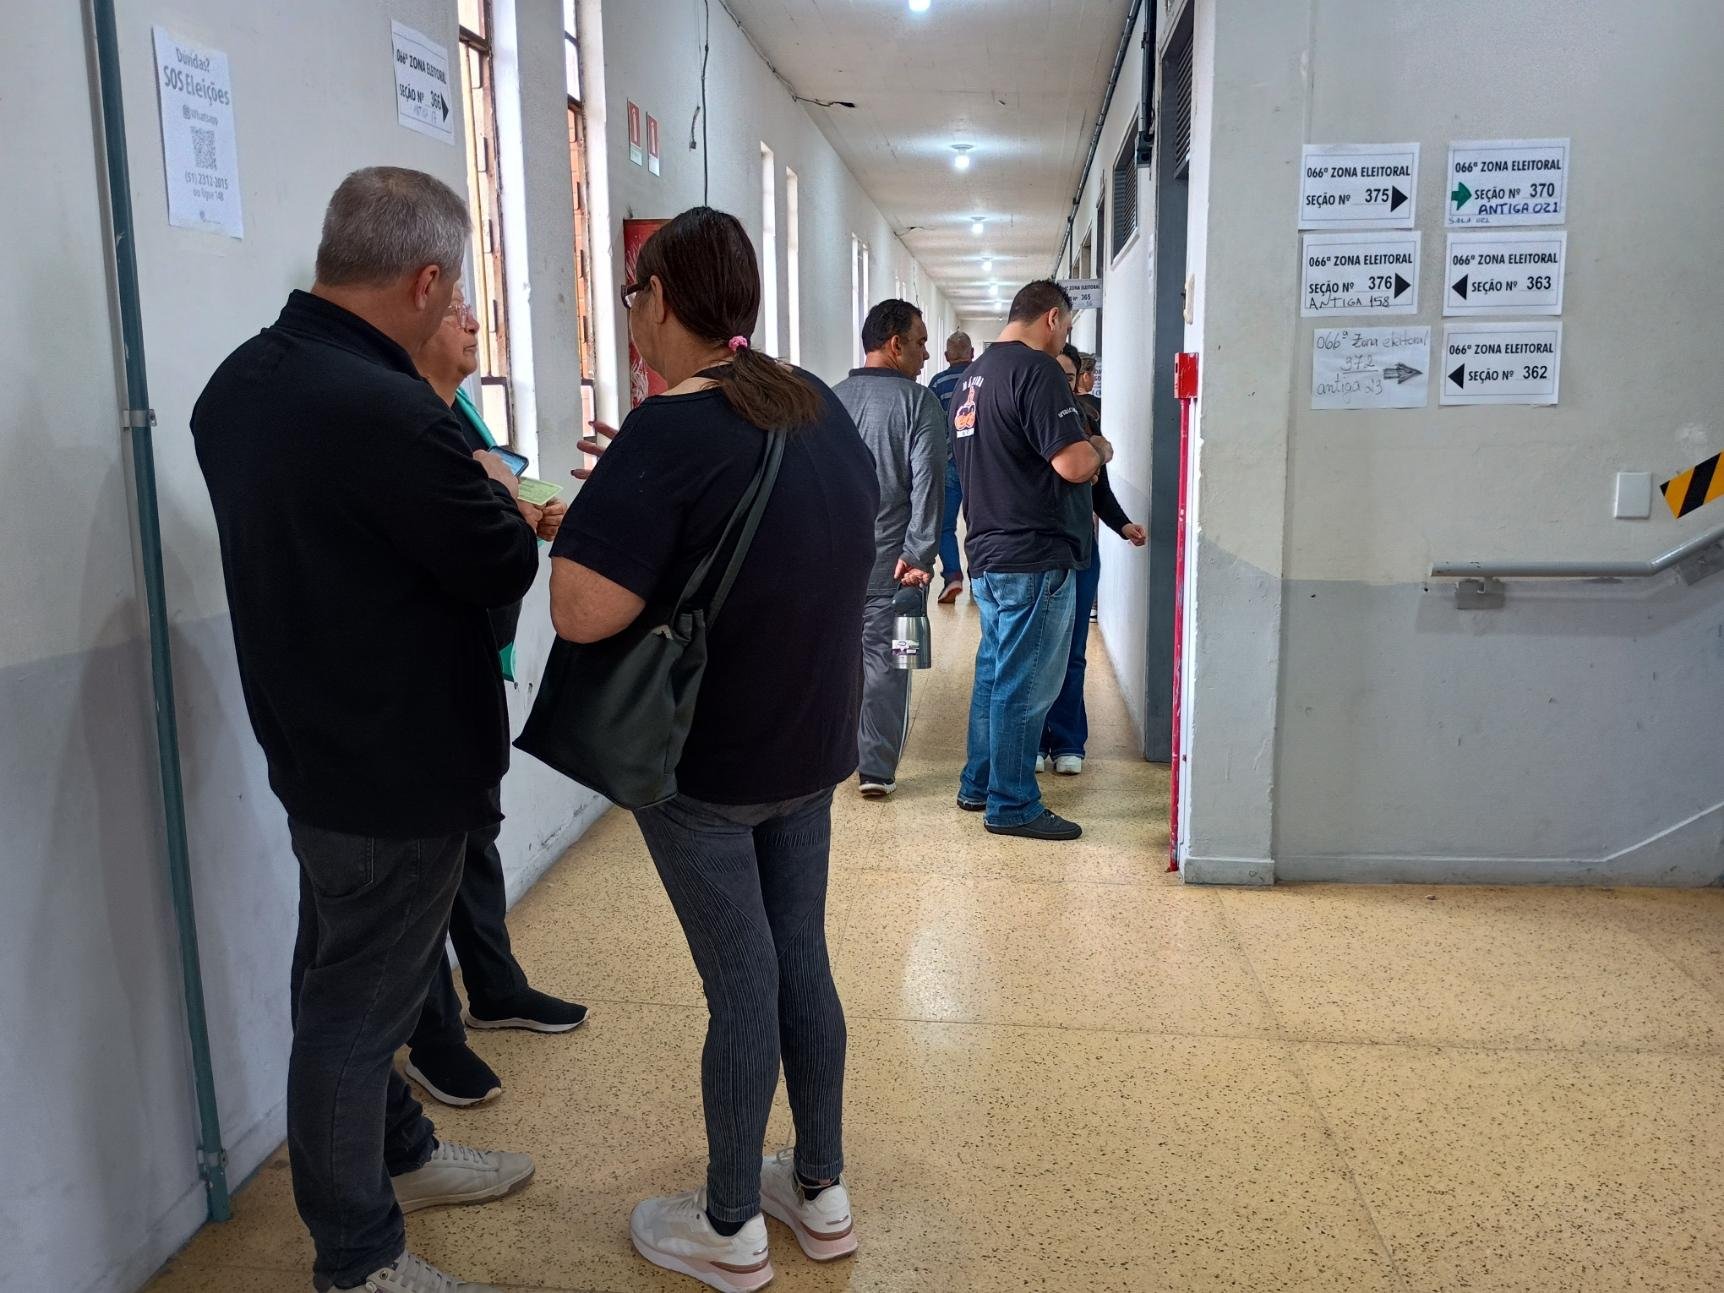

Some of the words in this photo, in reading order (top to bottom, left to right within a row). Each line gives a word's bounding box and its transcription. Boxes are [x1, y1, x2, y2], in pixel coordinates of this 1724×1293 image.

[409, 55, 426, 74] ZONA
[426, 62, 447, 85] ELEITORAL
[163, 65, 184, 92] SOS
[185, 73, 230, 106] Eleições
[399, 83, 416, 102] SEÇÃO
[1330, 167, 1358, 178] ZONA
[1360, 165, 1411, 177] ELEITORAL
[1480, 160, 1509, 172] ZONA
[1511, 159, 1562, 171] ELEITORAL
[1306, 192, 1336, 208] SEÇÃO
[1338, 194, 1351, 205] Nº
[1364, 188, 1390, 203] 375
[1474, 187, 1506, 202] SEÇÃO
[1508, 188, 1520, 199] Nº
[1529, 182, 1555, 198] 370
[1478, 202, 1529, 216] ANTIGA
[1333, 255, 1361, 266] ZONA
[1363, 253, 1413, 265] ELEITORAL
[1477, 254, 1506, 265] ZONA
[1508, 252, 1558, 264] ELEITORAL
[1308, 281, 1339, 296] SEÇÃO
[1342, 282, 1354, 293] Nº
[1368, 275, 1393, 290] 376
[1471, 279, 1502, 295] SEÇÃO
[1505, 281, 1518, 292] Nº
[1526, 276, 1552, 290] 363
[1309, 295, 1362, 310] ANTIGA
[1369, 295, 1390, 308] 158
[1474, 343, 1502, 355] ZONA
[1504, 342, 1554, 354] ELEITORAL
[1468, 368, 1499, 384] SEÇÃO
[1501, 370, 1514, 381] Nº
[1522, 365, 1548, 380] 362
[1317, 373, 1361, 404] antiga
